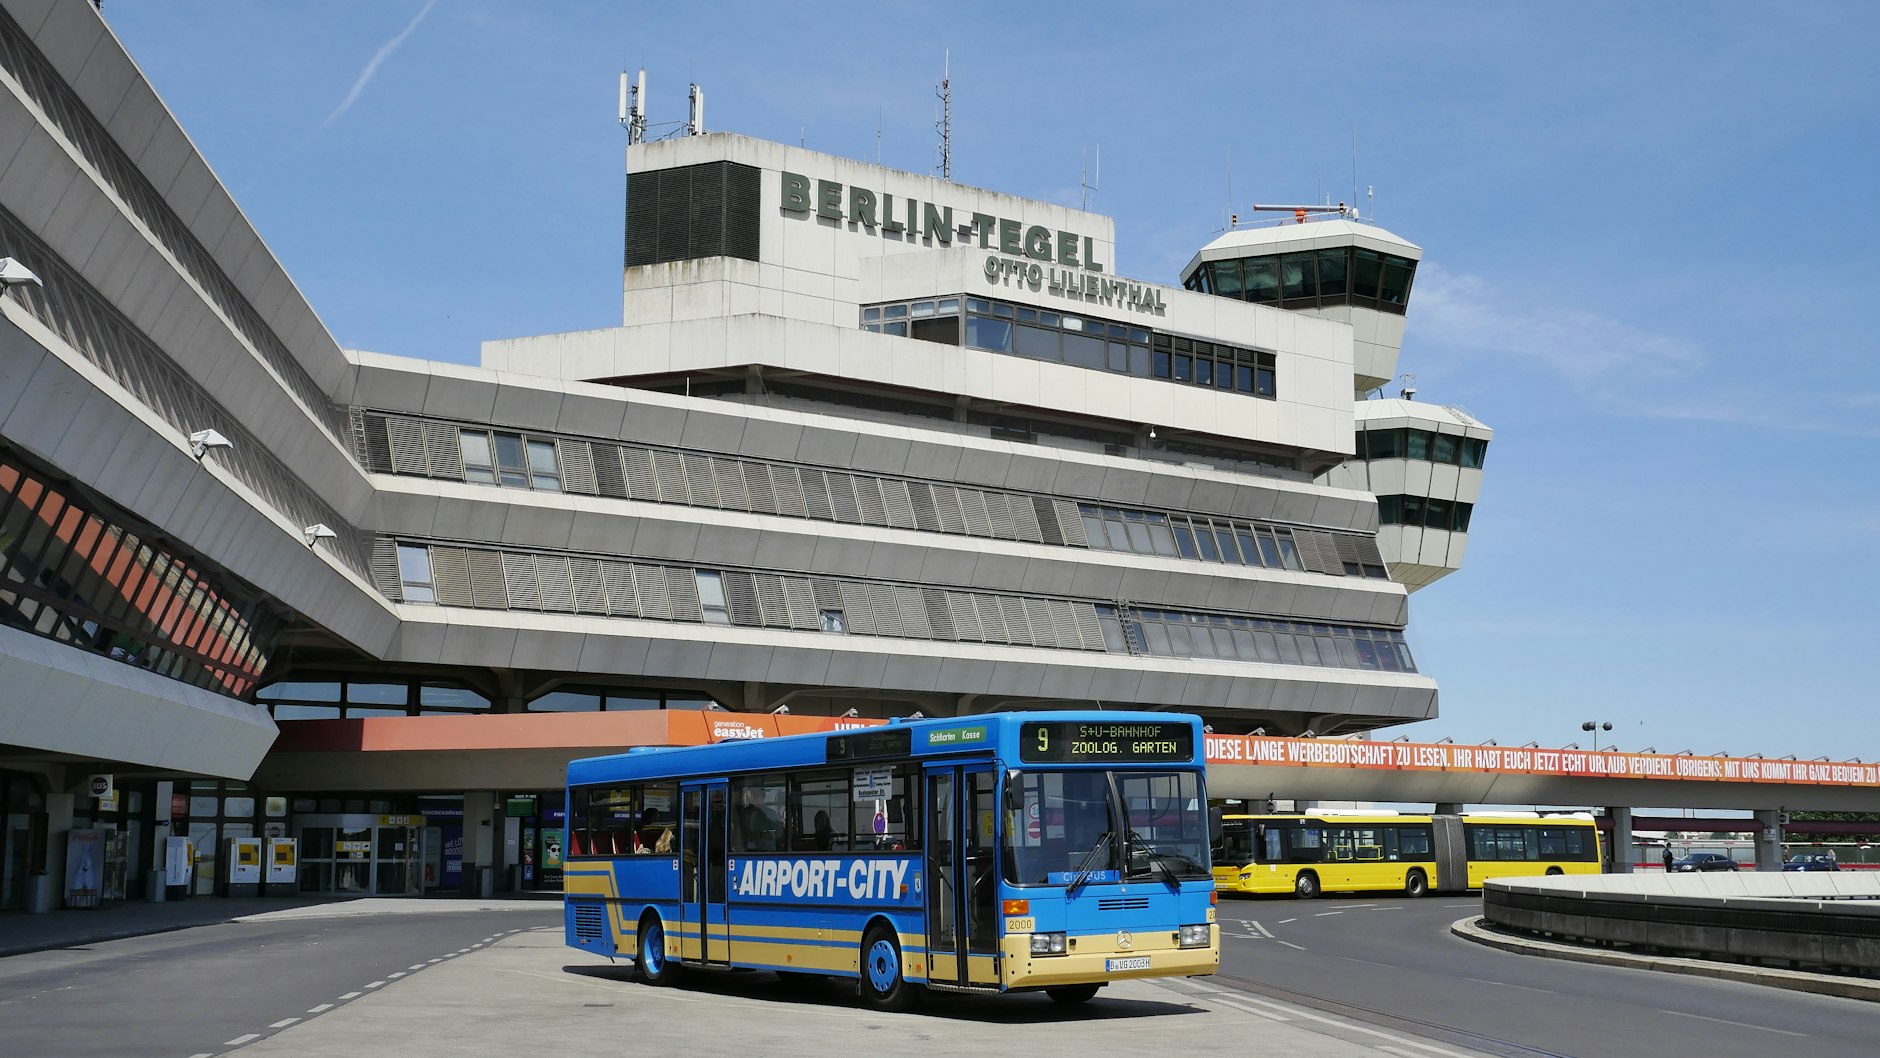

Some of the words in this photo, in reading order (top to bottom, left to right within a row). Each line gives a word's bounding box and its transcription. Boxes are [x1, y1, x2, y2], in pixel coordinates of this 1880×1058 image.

[780, 170, 1104, 272] BERLIN-TEGEL
[983, 254, 1043, 285] OTTO
[1048, 266, 1167, 310] LILIENTHAL
[714, 720, 745, 729] generation
[714, 726, 764, 739] easyJet
[929, 733, 956, 743] Sichtkarten
[961, 730, 981, 741] Kasse
[1079, 725, 1162, 738] S+U-BAHNHOF
[1037, 727, 1049, 752] 9
[839, 738, 846, 755] 9
[1071, 741, 1124, 754] ZOOLOG.
[1132, 741, 1177, 754] GARTEN
[1205, 738, 1242, 760] DIESE
[1245, 739, 1285, 761] LANGE
[1287, 741, 1394, 766] WERBEBOTSCHAFT
[1396, 746, 1411, 766] ZU
[1413, 746, 1451, 768] LESEN.
[1453, 748, 1472, 768] IHR
[1475, 749, 1502, 769] HABT
[1504, 750, 1531, 770] EUCH
[1533, 751, 1560, 771] JETZT
[1562, 753, 1586, 772] ECHT
[1588, 754, 1627, 774] URLAUB
[1628, 756, 1674, 776] VERDIENT.
[1675, 757, 1723, 778] ÜBRIGENS:
[1724, 760, 1740, 778] MIT
[1742, 761, 1759, 779] UNS
[1761, 762, 1792, 780] KOMMT
[1792, 763, 1808, 780] IHR
[1808, 764, 1831, 781] GANZ
[1832, 765, 1864, 783] BEQUEM
[1866, 767, 1876, 783] ZU
[92, 782, 107, 790] BUS
[738, 859, 910, 900] AIRPORT-CITY
[1009, 919, 1032, 930] 2000
